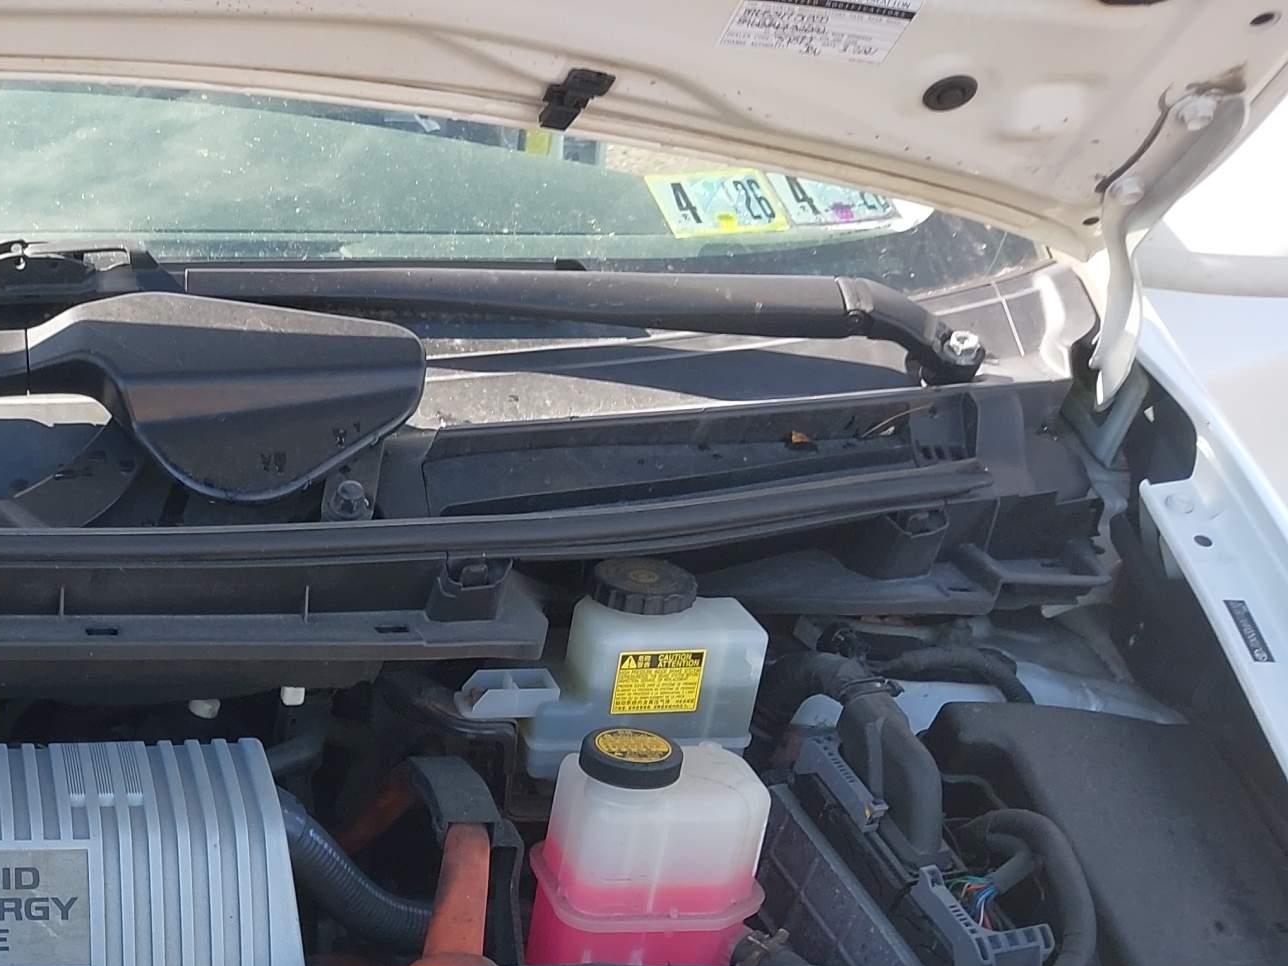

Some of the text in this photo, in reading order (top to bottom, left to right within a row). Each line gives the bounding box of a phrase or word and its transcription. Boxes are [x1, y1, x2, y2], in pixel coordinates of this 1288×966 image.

[670, 178, 776, 224] 4 26
[658, 653, 693, 662] CAUTION
[657, 659, 700, 668] ATTENTION
